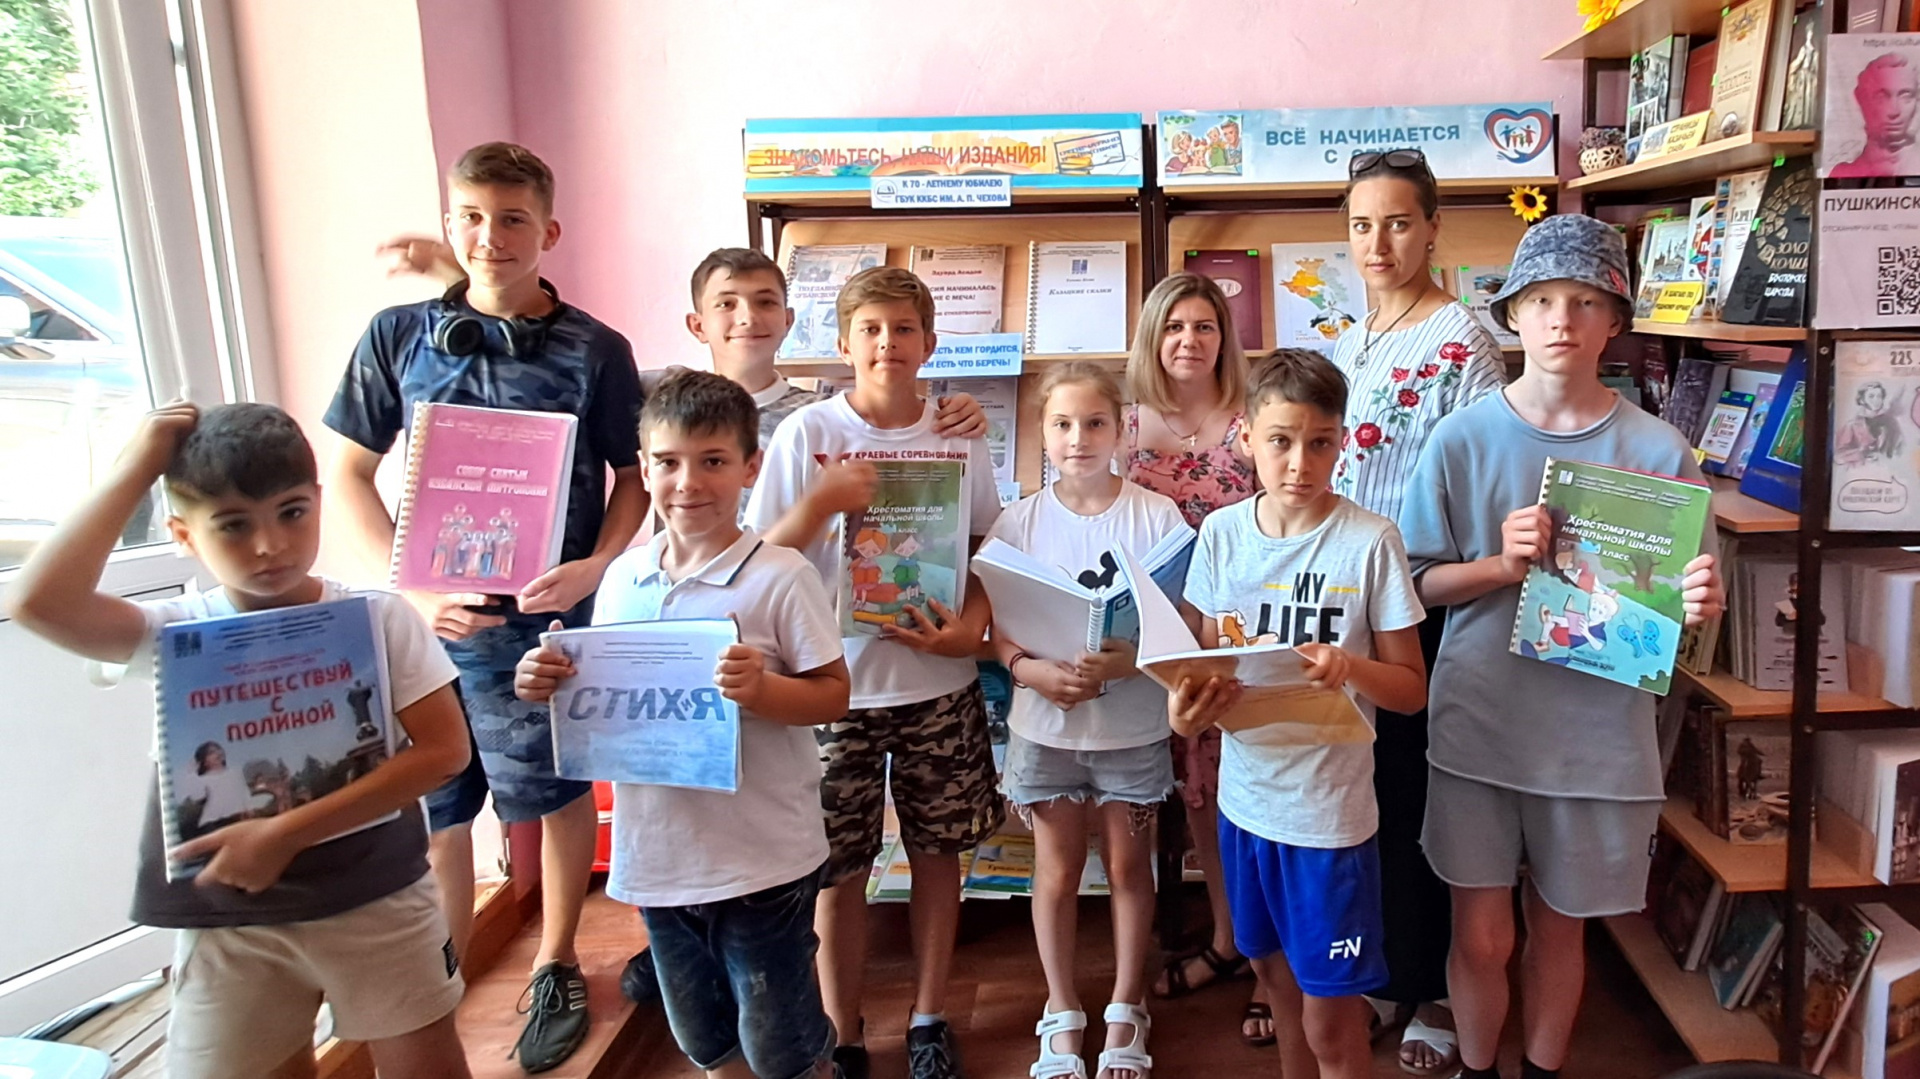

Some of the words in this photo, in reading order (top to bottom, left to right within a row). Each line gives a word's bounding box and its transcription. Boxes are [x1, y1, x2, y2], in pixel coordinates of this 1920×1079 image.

[1265, 127, 1306, 146] ВСЁ
[1320, 125, 1460, 145] НАЧИНАЕТСЯ
[902, 146, 953, 166] НАШИ
[960, 144, 1047, 168] ИЗДАНИЯ!
[1324, 149, 1338, 164] С
[902, 180, 909, 189] К
[910, 180, 920, 189] 70
[926, 179, 963, 189] ЛЕТНЕМУ
[964, 179, 1003, 188] ЮБИЛЕЮ
[895, 195, 915, 204] ГБУК
[940, 194, 956, 203] ИМ.
[957, 194, 966, 203] А.
[967, 194, 976, 203] П.
[977, 193, 1008, 203] ЧЕХОВА
[1824, 195, 1920, 212] ПУШКИНСК
[1775, 241, 1808, 254] ЗОЛО
[955, 346, 973, 355] КЕМ
[975, 345, 1020, 355] ГОРДИТСЯ,
[1890, 350, 1914, 366] 225
[936, 360, 956, 368] ЕСТЬ
[958, 359, 975, 367] ЧТО
[976, 358, 1011, 368] БЕРЕЧЬ!
[855, 450, 899, 460] КРАЕВЫЕ
[901, 450, 969, 460] СОРЕВНОВАНИЯ
[867, 504, 926, 514] Хрестоматия
[927, 505, 944, 514] для
[863, 513, 914, 522] начальной
[915, 514, 944, 522] школы
[1567, 514, 1646, 540] Хрестоматия
[1646, 534, 1673, 547] для
[1561, 525, 1626, 546] начальной
[1627, 541, 1672, 557] школы
[1602, 549, 1631, 561] класс
[1291, 571, 1327, 604] MY
[1256, 602, 1344, 648] LIFE
[189, 657, 353, 709] ПУТЕШЕСТВУЙ
[227, 698, 336, 742] ПОЛИНОЙ
[1329, 936, 1361, 960] FN
